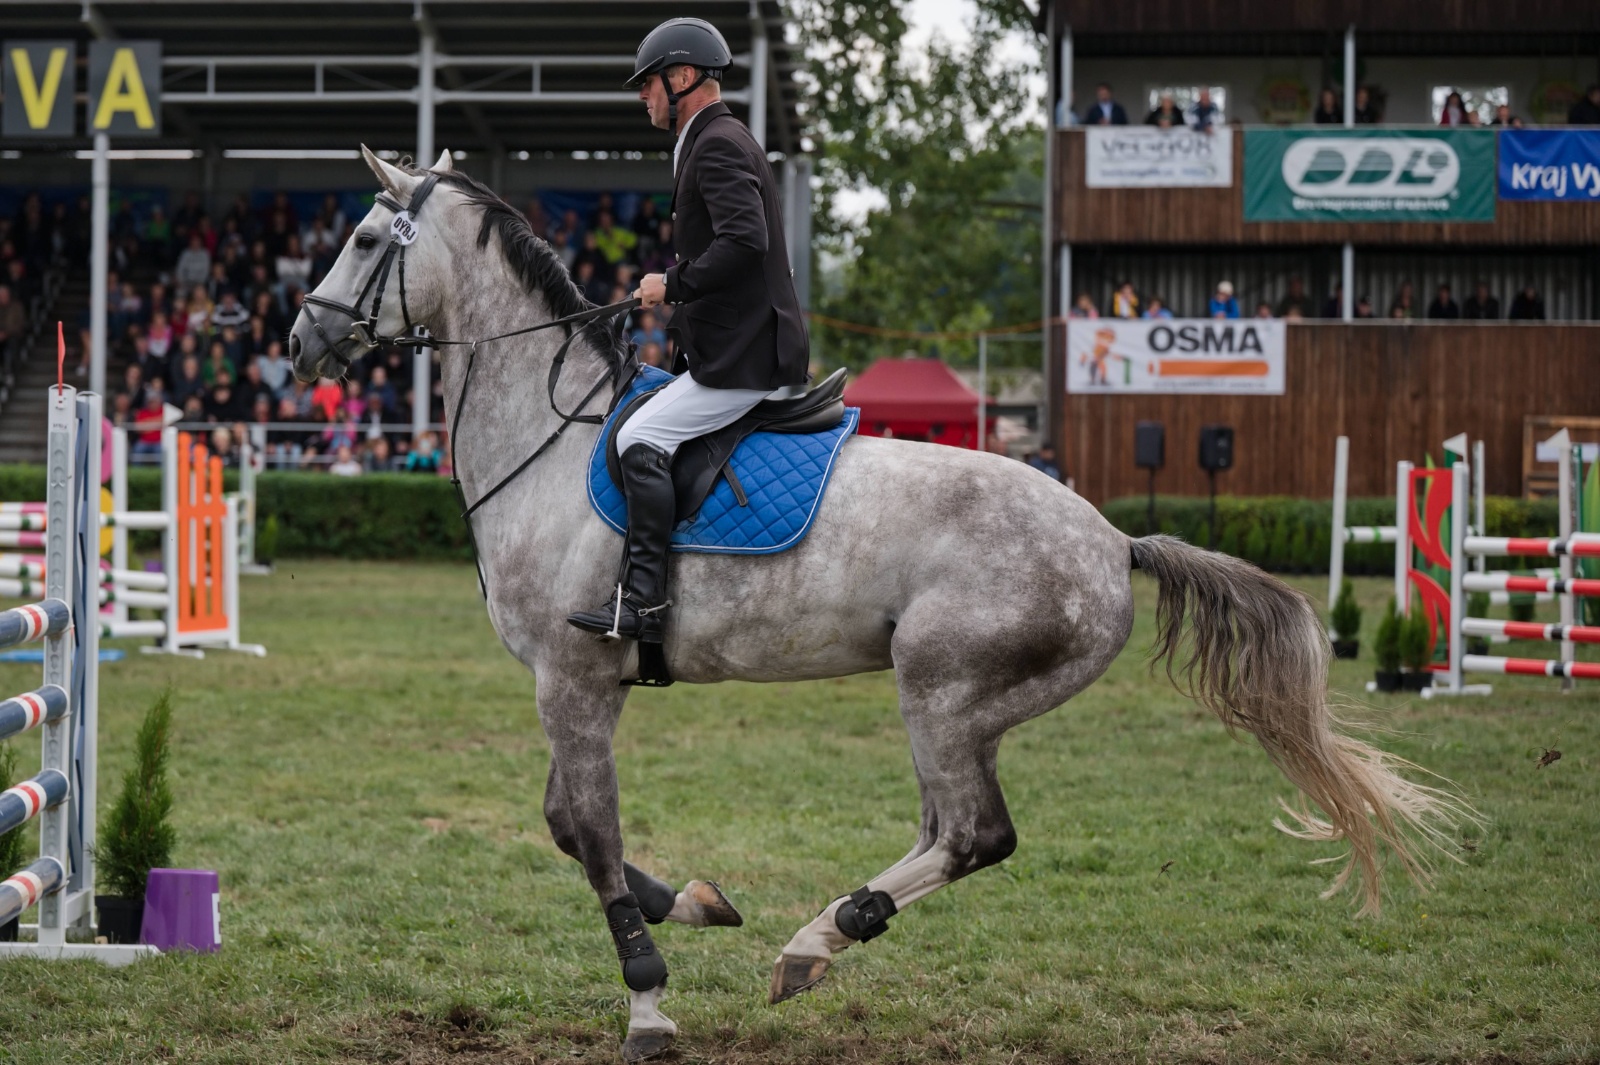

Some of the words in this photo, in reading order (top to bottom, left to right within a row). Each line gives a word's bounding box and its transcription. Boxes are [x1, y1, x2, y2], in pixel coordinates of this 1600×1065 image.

[11, 48, 67, 129] V
[93, 48, 155, 129] A
[1511, 162, 1567, 197] Kraj
[1147, 325, 1263, 354] OSMA
